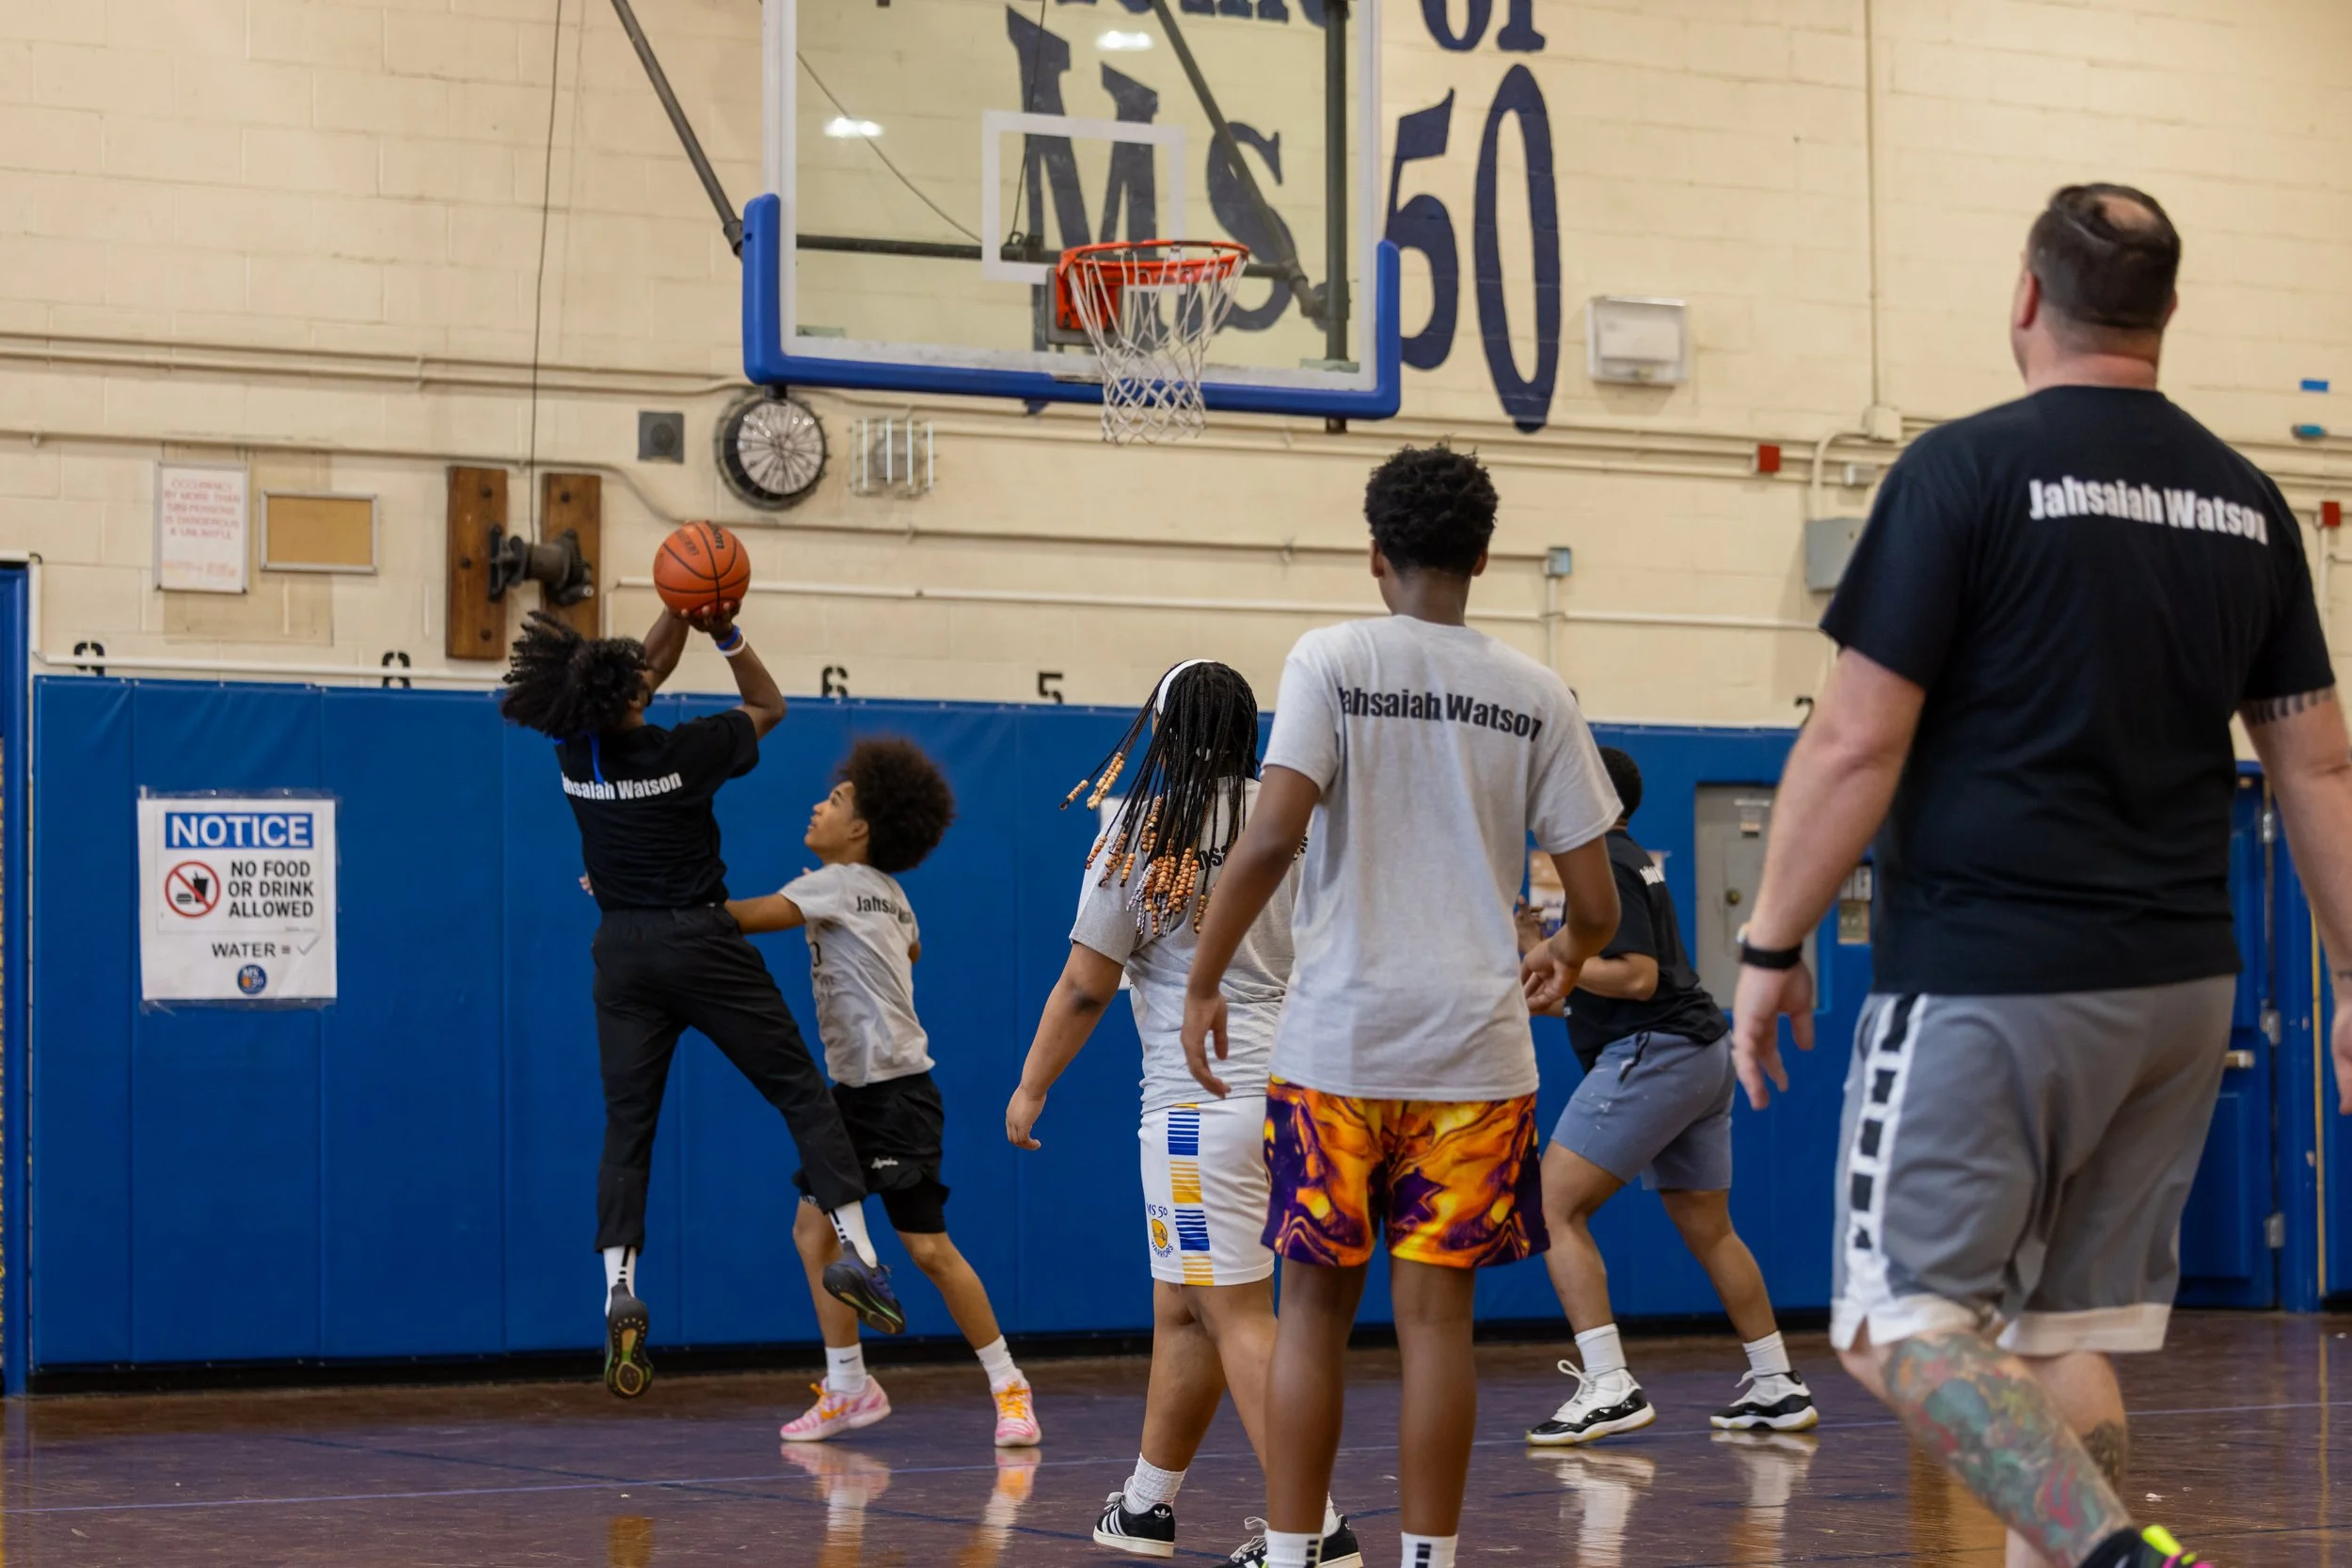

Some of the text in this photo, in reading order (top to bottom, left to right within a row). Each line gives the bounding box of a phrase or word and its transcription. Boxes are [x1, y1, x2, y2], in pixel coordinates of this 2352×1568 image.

[1007, 6, 1559, 434] MS 50
[2028, 475, 2268, 546] Jahsaiah Watson
[1038, 672, 1063, 704] 5
[1338, 687, 1441, 721] ahsaiah
[616, 771, 683, 800] Watson
[171, 815, 310, 847] NOTICE
[230, 861, 310, 878] NO FOOD
[228, 881, 314, 897] OR DRINK
[228, 901, 314, 918] ALLOWED
[212, 942, 277, 958] WATER
[1157, 1206, 1168, 1219] 50
[1152, 1238, 1174, 1259] WARRIORS
